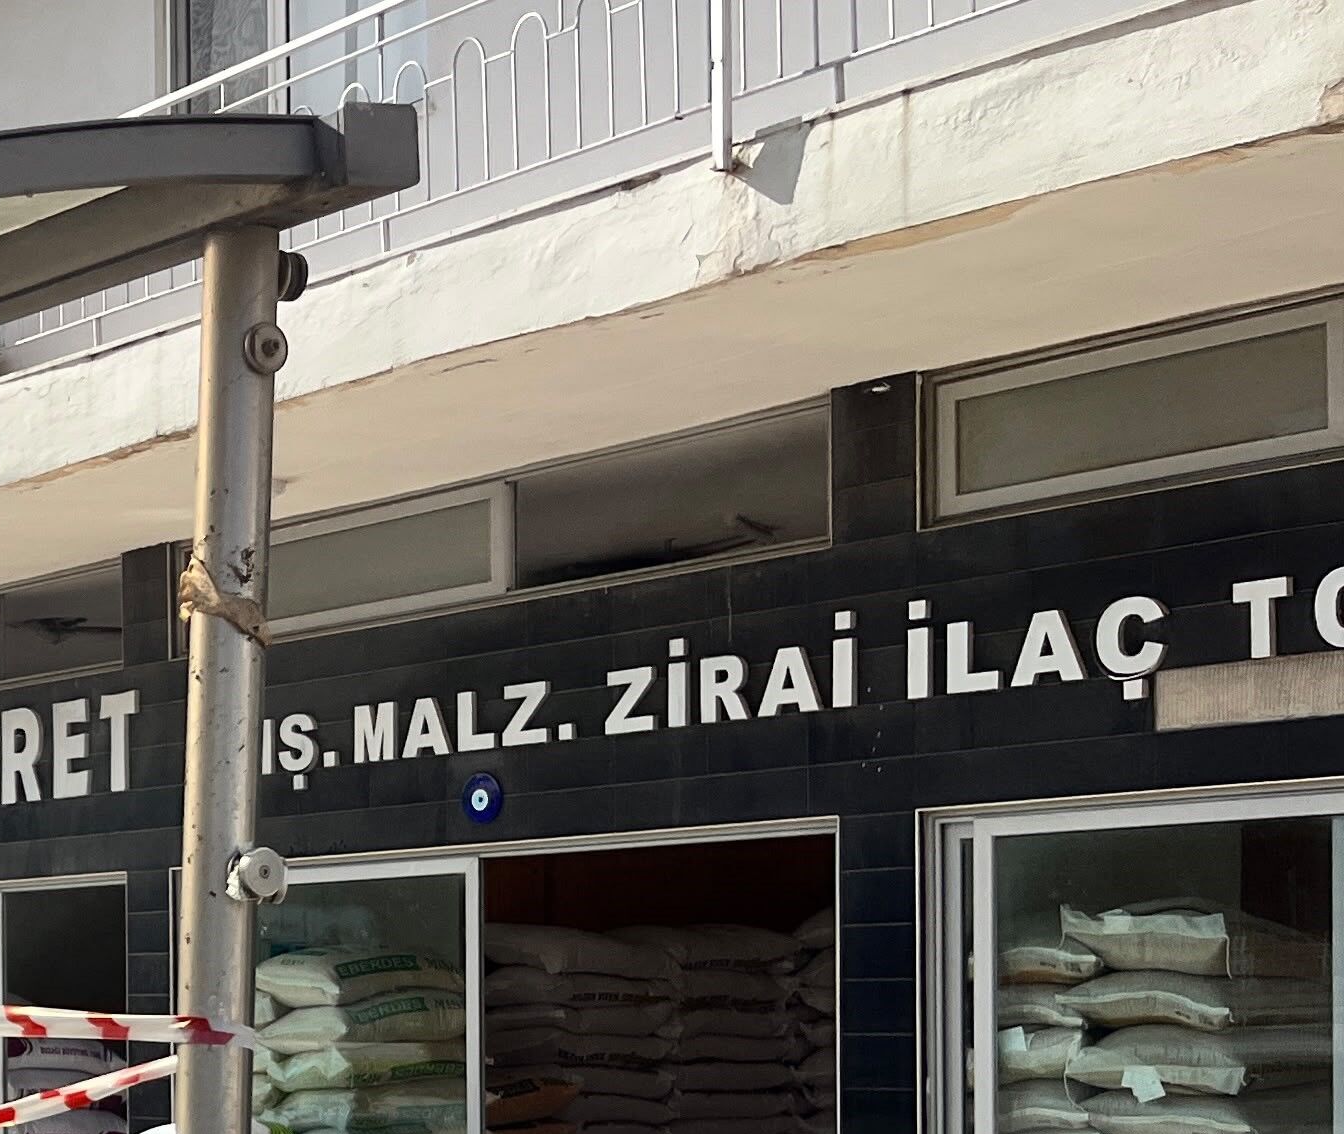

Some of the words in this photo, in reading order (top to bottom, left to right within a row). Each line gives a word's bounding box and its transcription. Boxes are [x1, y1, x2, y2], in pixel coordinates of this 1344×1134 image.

[353, 682, 578, 763] MALZ.
[605, 610, 858, 735] ZİRAİ
[907, 596, 1171, 701] İLAÇ
